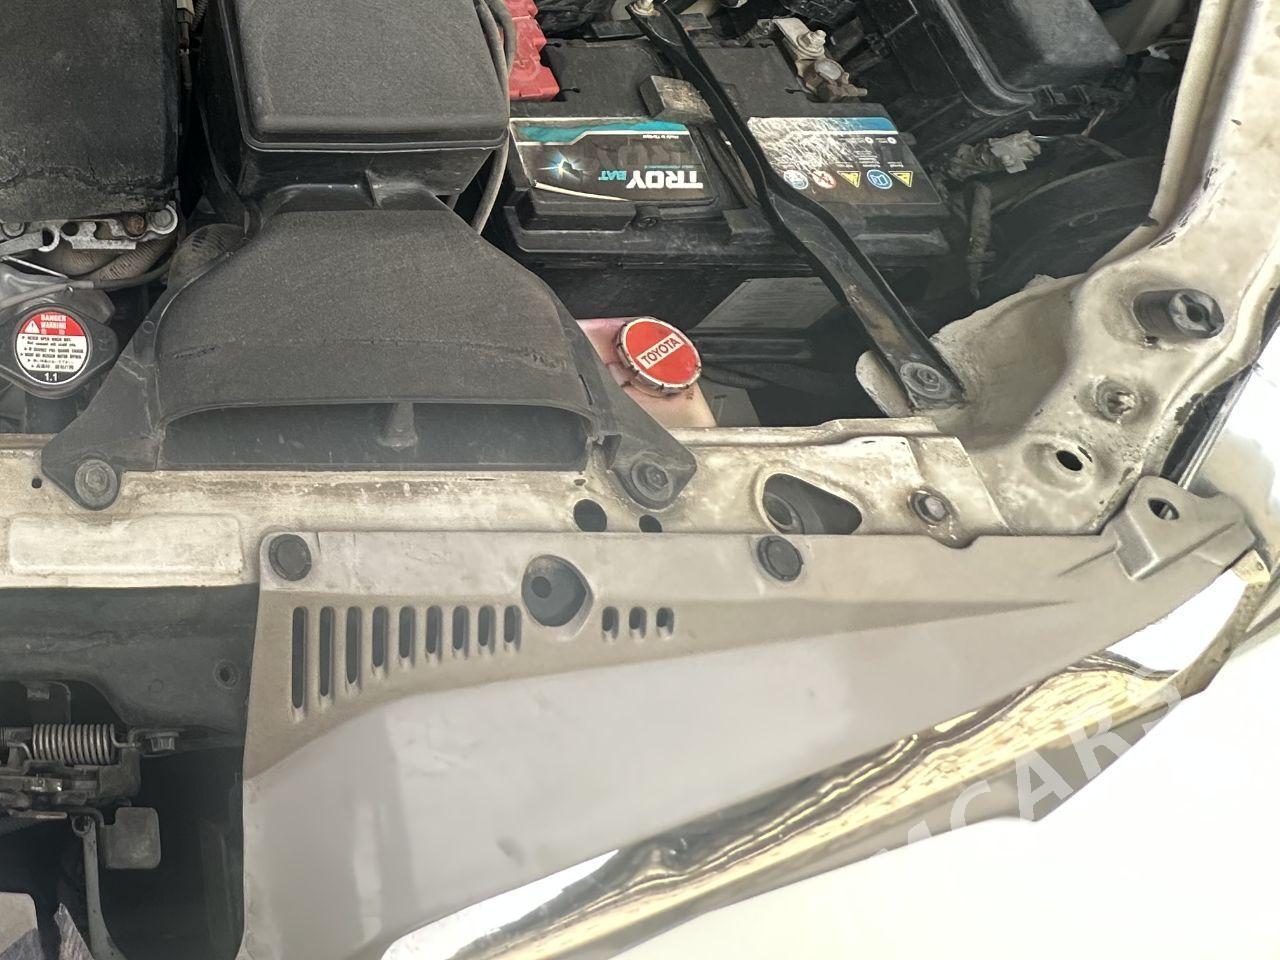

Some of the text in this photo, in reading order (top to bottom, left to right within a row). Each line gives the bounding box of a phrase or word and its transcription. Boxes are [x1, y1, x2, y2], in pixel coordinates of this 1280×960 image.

[598, 170, 704, 189] TROY BAT
[640, 337, 681, 366] TOYOTA
[44, 372, 58, 382] 1.1
